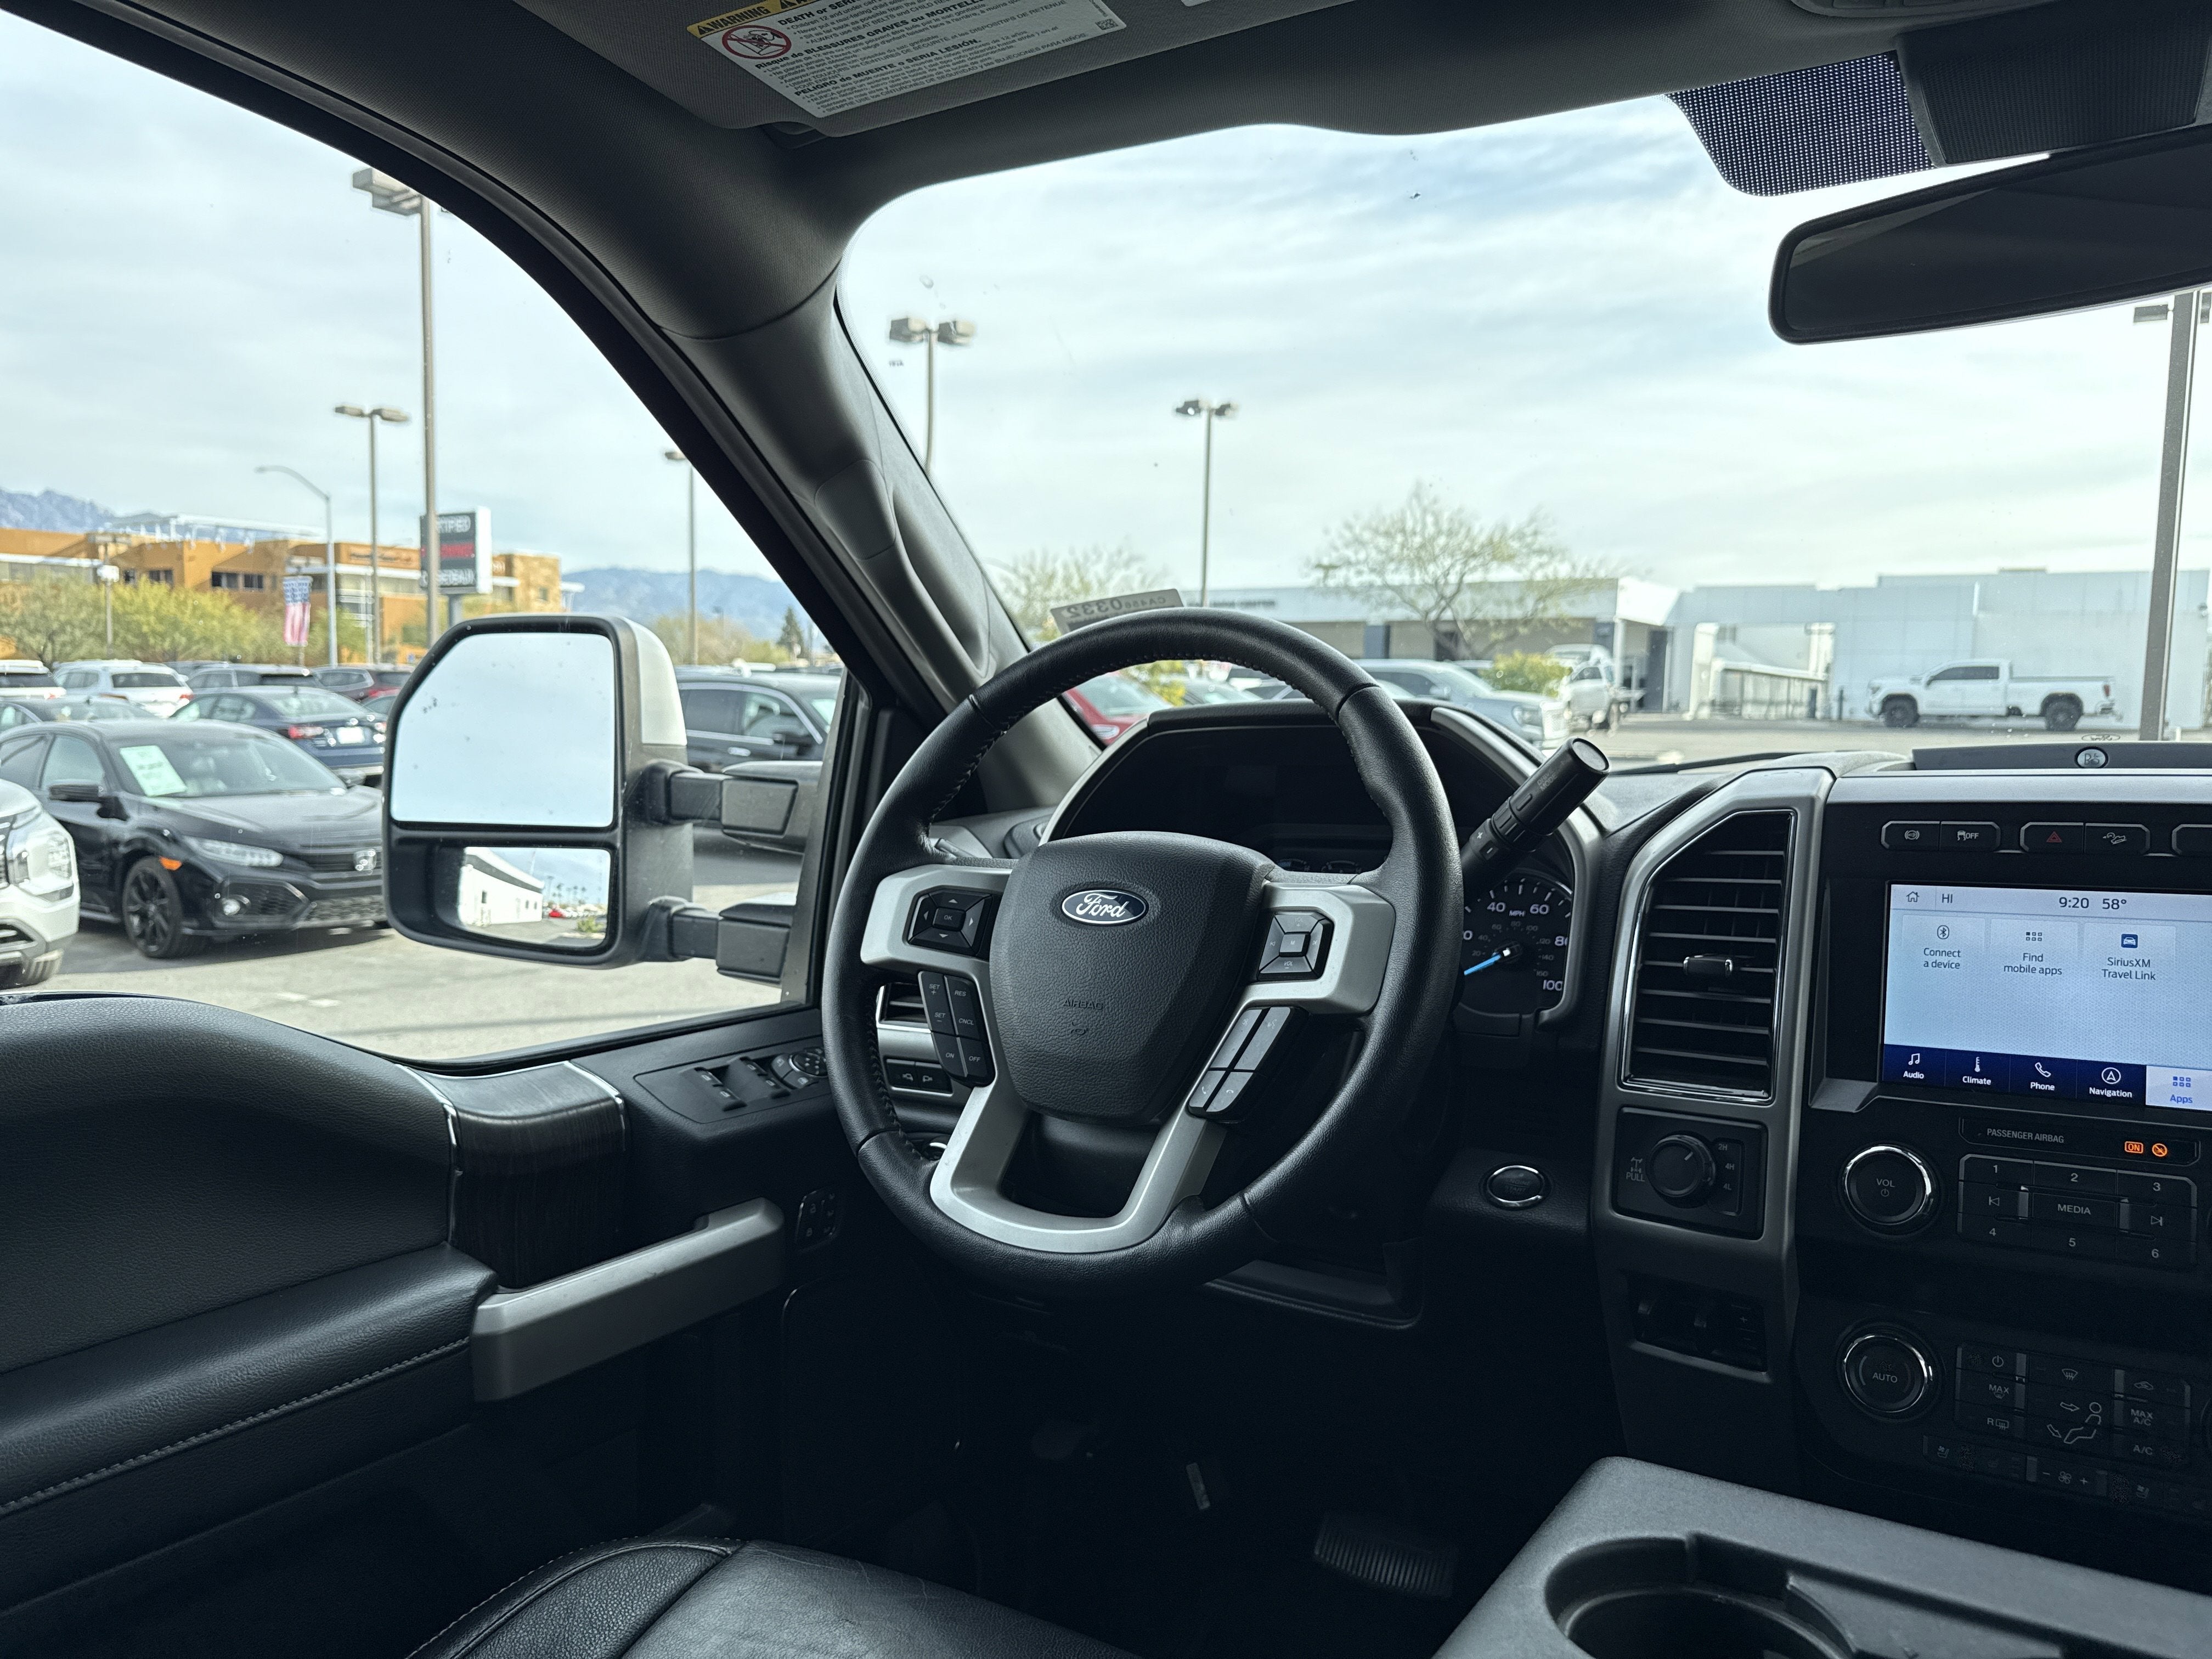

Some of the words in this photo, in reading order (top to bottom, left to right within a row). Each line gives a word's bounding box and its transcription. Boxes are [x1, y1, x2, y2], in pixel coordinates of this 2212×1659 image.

[708, 6, 770, 29] WARNING
[778, 12, 814, 25] DEATH
[791, 19, 819, 29] Children
[843, 4, 862, 13] under
[860, 10, 887, 22] possible
[810, 33, 839, 43] ALWAYS
[852, 22, 870, 31] SEAT
[871, 14, 895, 24] BELTS
[910, 2, 933, 12] CHILD
[755, 57, 789, 69] Risque
[805, 35, 865, 53] BLESSURES
[867, 20, 909, 36] GRAVES
[794, 80, 837, 95] PELIGRO
[853, 64, 895, 77] MUERTE
[906, 52, 938, 63] SERIA
[939, 39, 980, 53] LESIÓN.
[1540, 773, 1558, 791] MODE
[1966, 832, 1979, 840] OFF
[1942, 894, 1953, 904] HI
[2059, 897, 2090, 909] 9:20
[2102, 899, 2127, 910] 58°
[1076, 893, 1127, 918] Ford
[1487, 902, 1506, 913] 40
[1530, 904, 1550, 915] 60
[1463, 930, 1474, 941] 0
[1923, 948, 1961, 958] Connect
[2023, 953, 2044, 962] Find
[1931, 960, 1960, 969] device
[2107, 957, 2151, 968] SiriusXM
[2004, 964, 2038, 974] mobile
[2040, 967, 2062, 977] apps
[2102, 969, 2132, 980] Travel
[2135, 970, 2156, 981] Link
[1543, 980, 1563, 991] 100
[1063, 998, 1104, 1010] AIRBAG
[1903, 1071, 1925, 1080] Audio
[1962, 1076, 1991, 1085] Climate
[2030, 1082, 2055, 1091] Phone
[2089, 1087, 2132, 1099] Navigation
[2170, 1094, 2193, 1105] Apps
[1987, 1128, 2034, 1141] PASSENGER
[2034, 1133, 2064, 1143] AIRBAG
[2128, 1143, 2141, 1152] ON
[1993, 1165, 1998, 1173] 1
[1626, 1172, 1645, 1183] PULL
[1877, 1178, 1895, 1188] VOL
[2071, 1173, 2078, 1182] 2
[2153, 1182, 2160, 1191] 3
[2057, 1204, 2091, 1215] MEDIA
[1989, 1228, 1996, 1236] 4
[2069, 1238, 2076, 1246] 5
[2152, 1249, 2159, 1258] 6
[1872, 1372, 1898, 1383] AUTO
[1989, 1384, 2010, 1395] MAX
[2131, 1408, 2153, 1419] MAX
[1987, 1418, 1994, 1426] R
[2134, 1417, 2151, 1426] A/C
[2133, 1444, 2153, 1455] A/C
